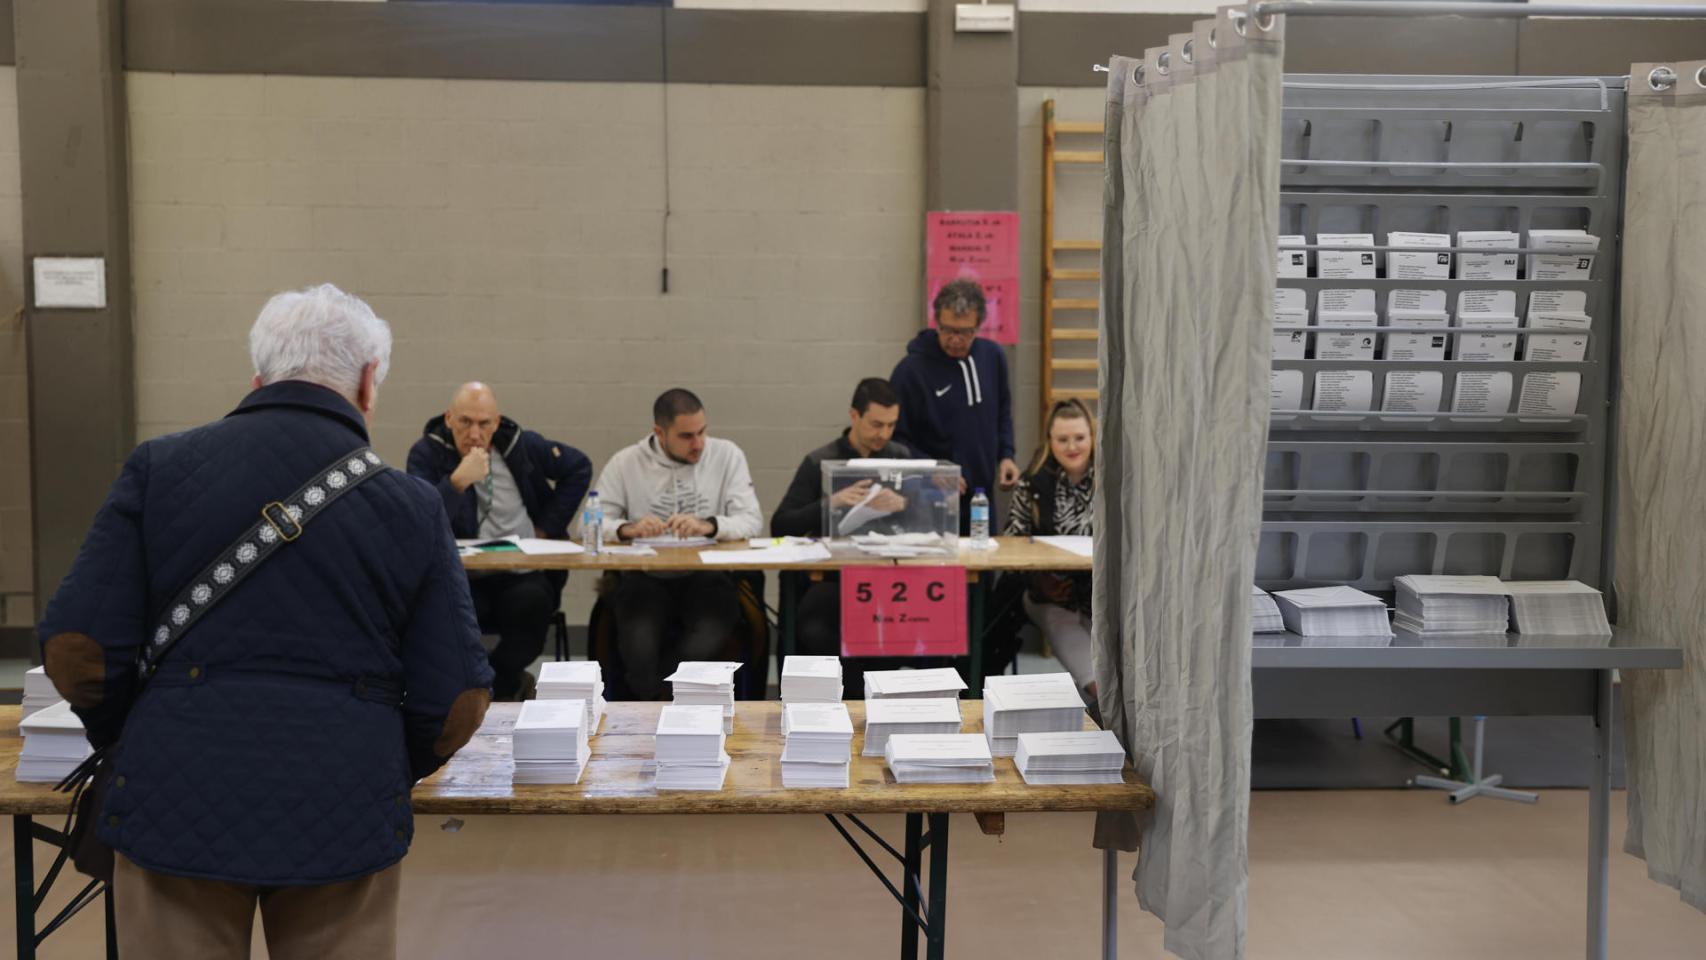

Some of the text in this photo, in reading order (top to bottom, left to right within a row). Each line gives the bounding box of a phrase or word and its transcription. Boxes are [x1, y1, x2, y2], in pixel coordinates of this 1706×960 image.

[856, 581, 945, 602] 5 2 C
